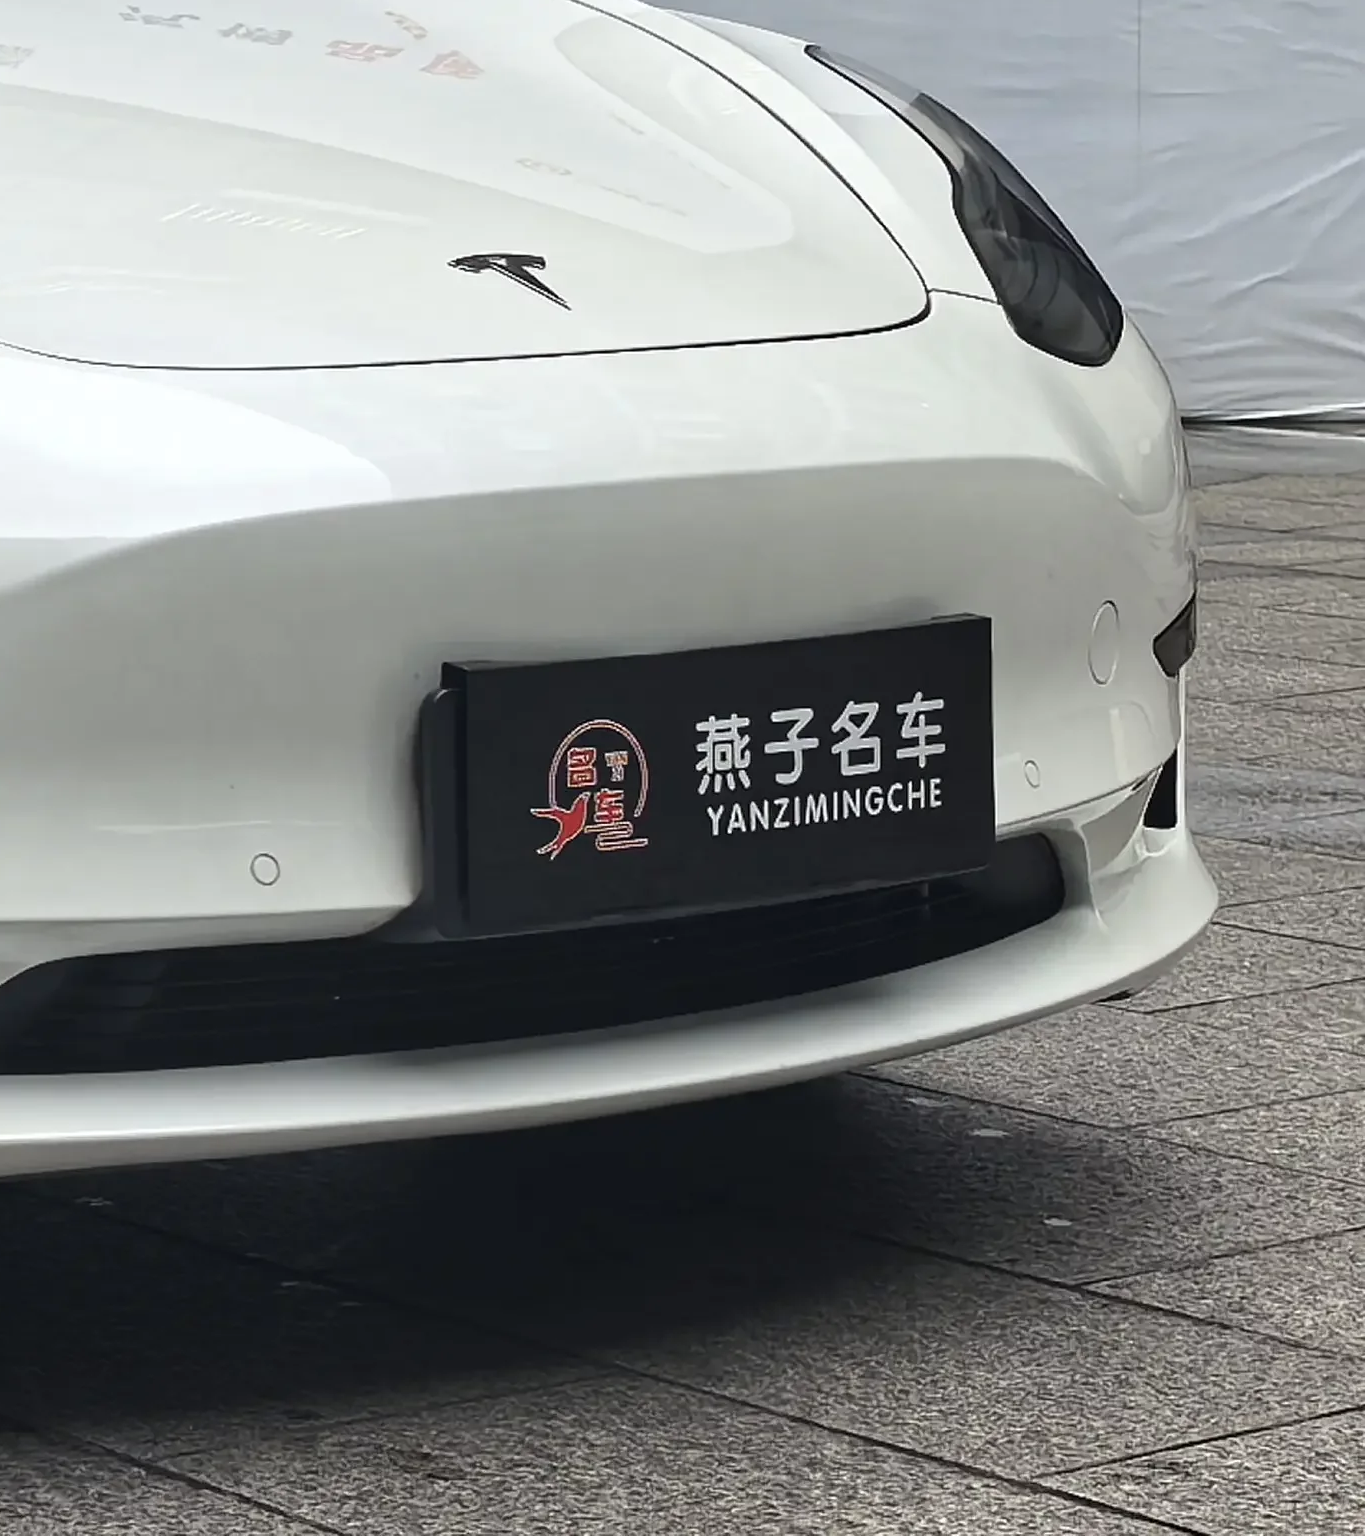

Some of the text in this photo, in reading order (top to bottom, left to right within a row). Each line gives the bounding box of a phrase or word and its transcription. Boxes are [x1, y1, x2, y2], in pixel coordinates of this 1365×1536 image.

[696, 692, 946, 795] 燕子名车
[707, 778, 943, 836] YANZIMINGCHE
